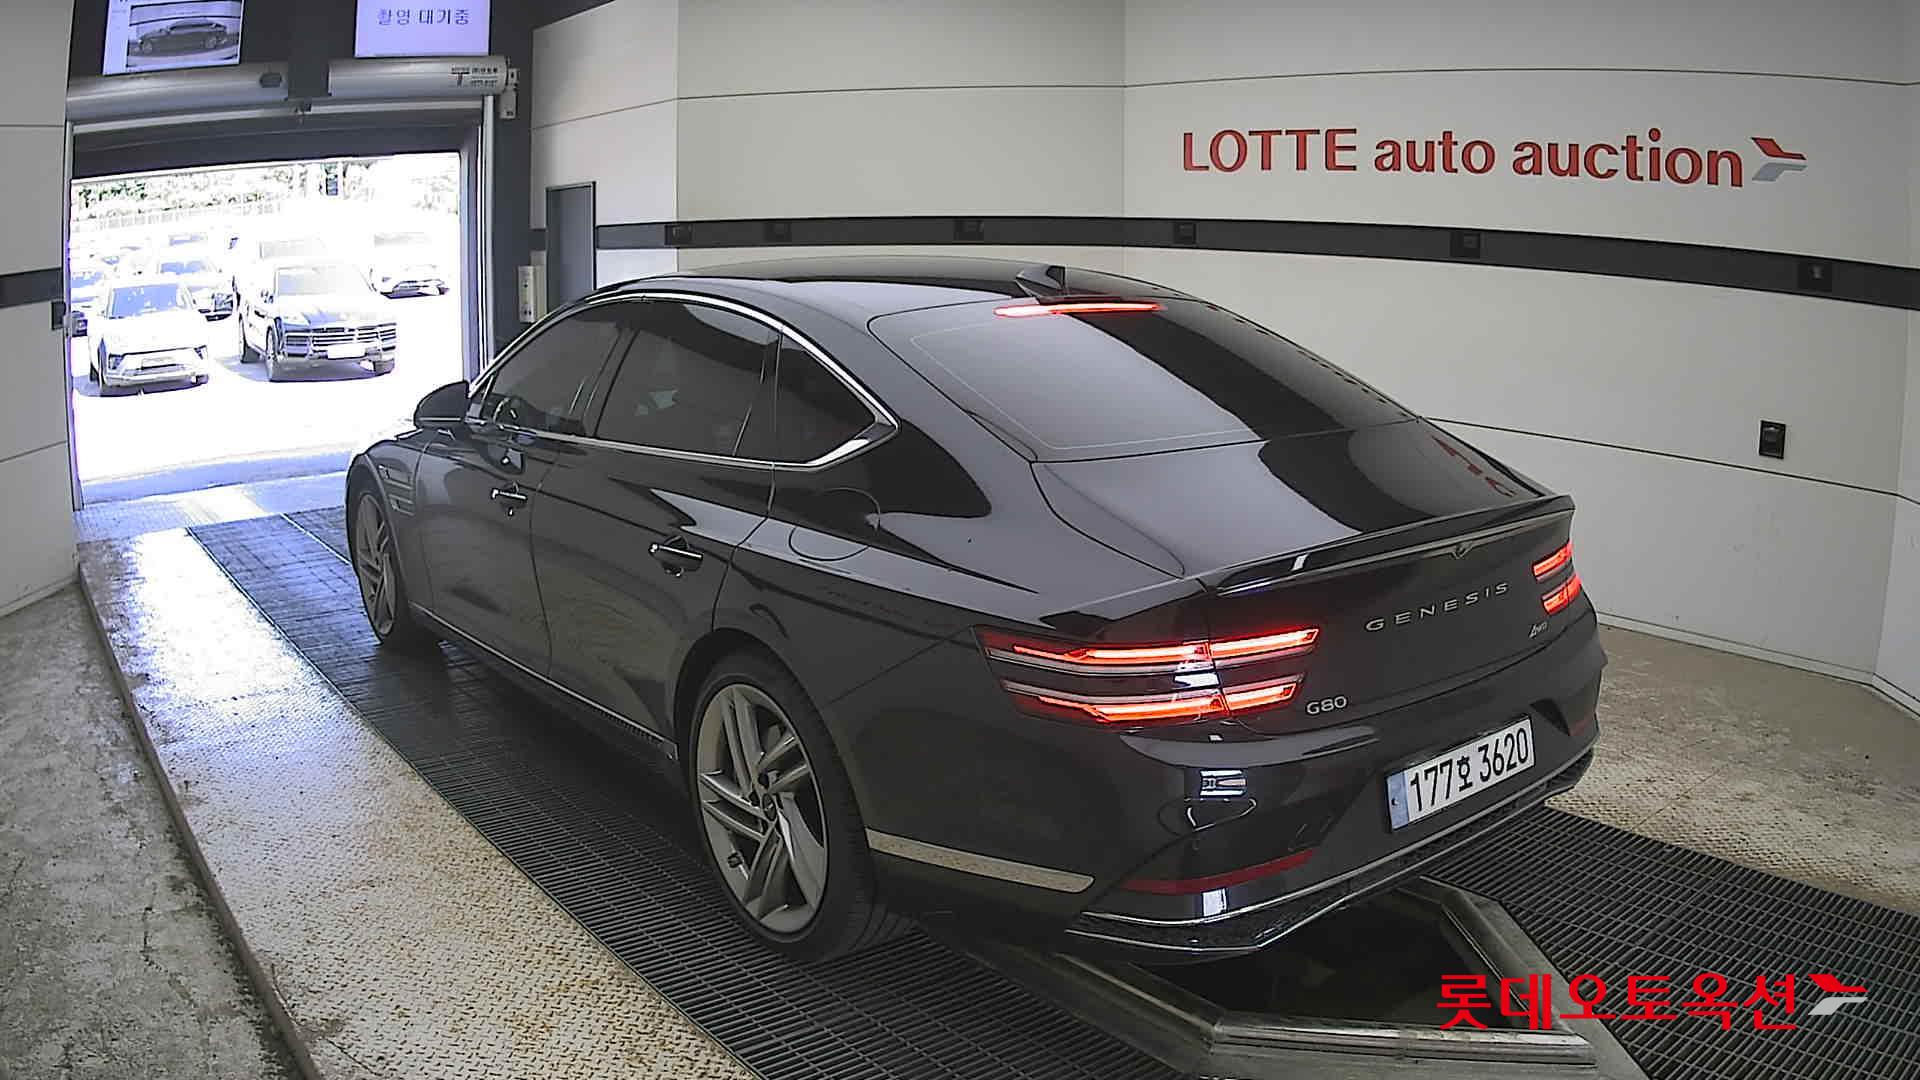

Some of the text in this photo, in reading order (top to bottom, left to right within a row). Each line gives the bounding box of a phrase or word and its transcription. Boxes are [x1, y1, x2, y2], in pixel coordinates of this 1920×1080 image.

[419, 8, 470, 26] 대기중
[1183, 127, 1744, 188] LOTTE auto auction
[1364, 581, 1511, 633] GENESIS
[1305, 694, 1348, 716] G80
[1477, 727, 1530, 783] 3620
